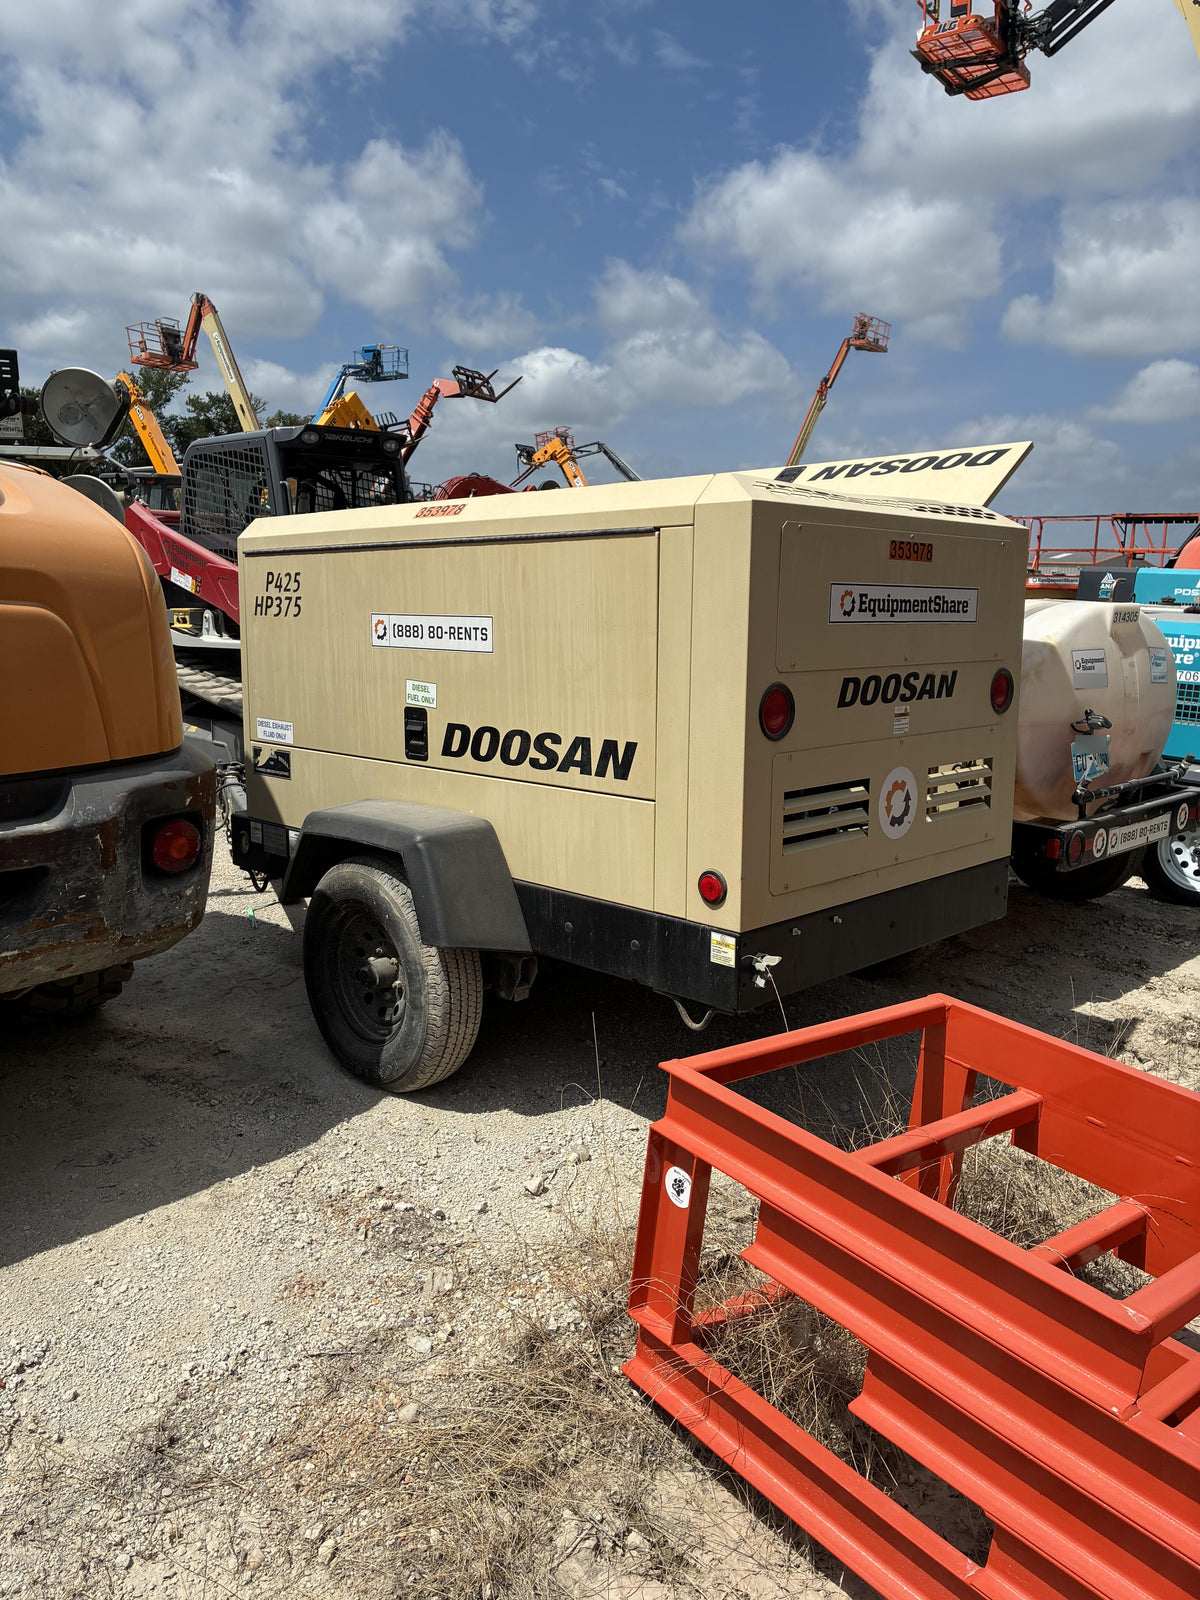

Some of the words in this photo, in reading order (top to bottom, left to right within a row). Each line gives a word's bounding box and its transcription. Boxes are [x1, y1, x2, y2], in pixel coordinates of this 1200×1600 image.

[934, 20, 958, 35] JLG
[807, 448, 1013, 481] DOOSAN
[415, 503, 467, 518] 353978
[171, 540, 207, 569] Equipment
[889, 540, 934, 561] 353978
[170, 552, 190, 571] Share
[265, 571, 302, 594] P425
[254, 595, 302, 618] HP375
[857, 592, 969, 618] EquipmentShare
[1112, 611, 1139, 624] 314305
[392, 623, 424, 640] (888)
[428, 625, 489, 642] 80-RENTS
[1081, 656, 1105, 665] Equipment
[411, 683, 431, 694] DIESEL
[836, 670, 959, 709] DOOSAN
[407, 693, 421, 703] FUEL
[421, 695, 436, 705] ONLY
[257, 719, 272, 729] DIESEL
[263, 730, 276, 739] FLUID
[275, 732, 287, 741] ONLY
[441, 722, 639, 781] DOOSAN
[1120, 828, 1138, 845] (888)
[1139, 820, 1169, 839] 80-RENTS
